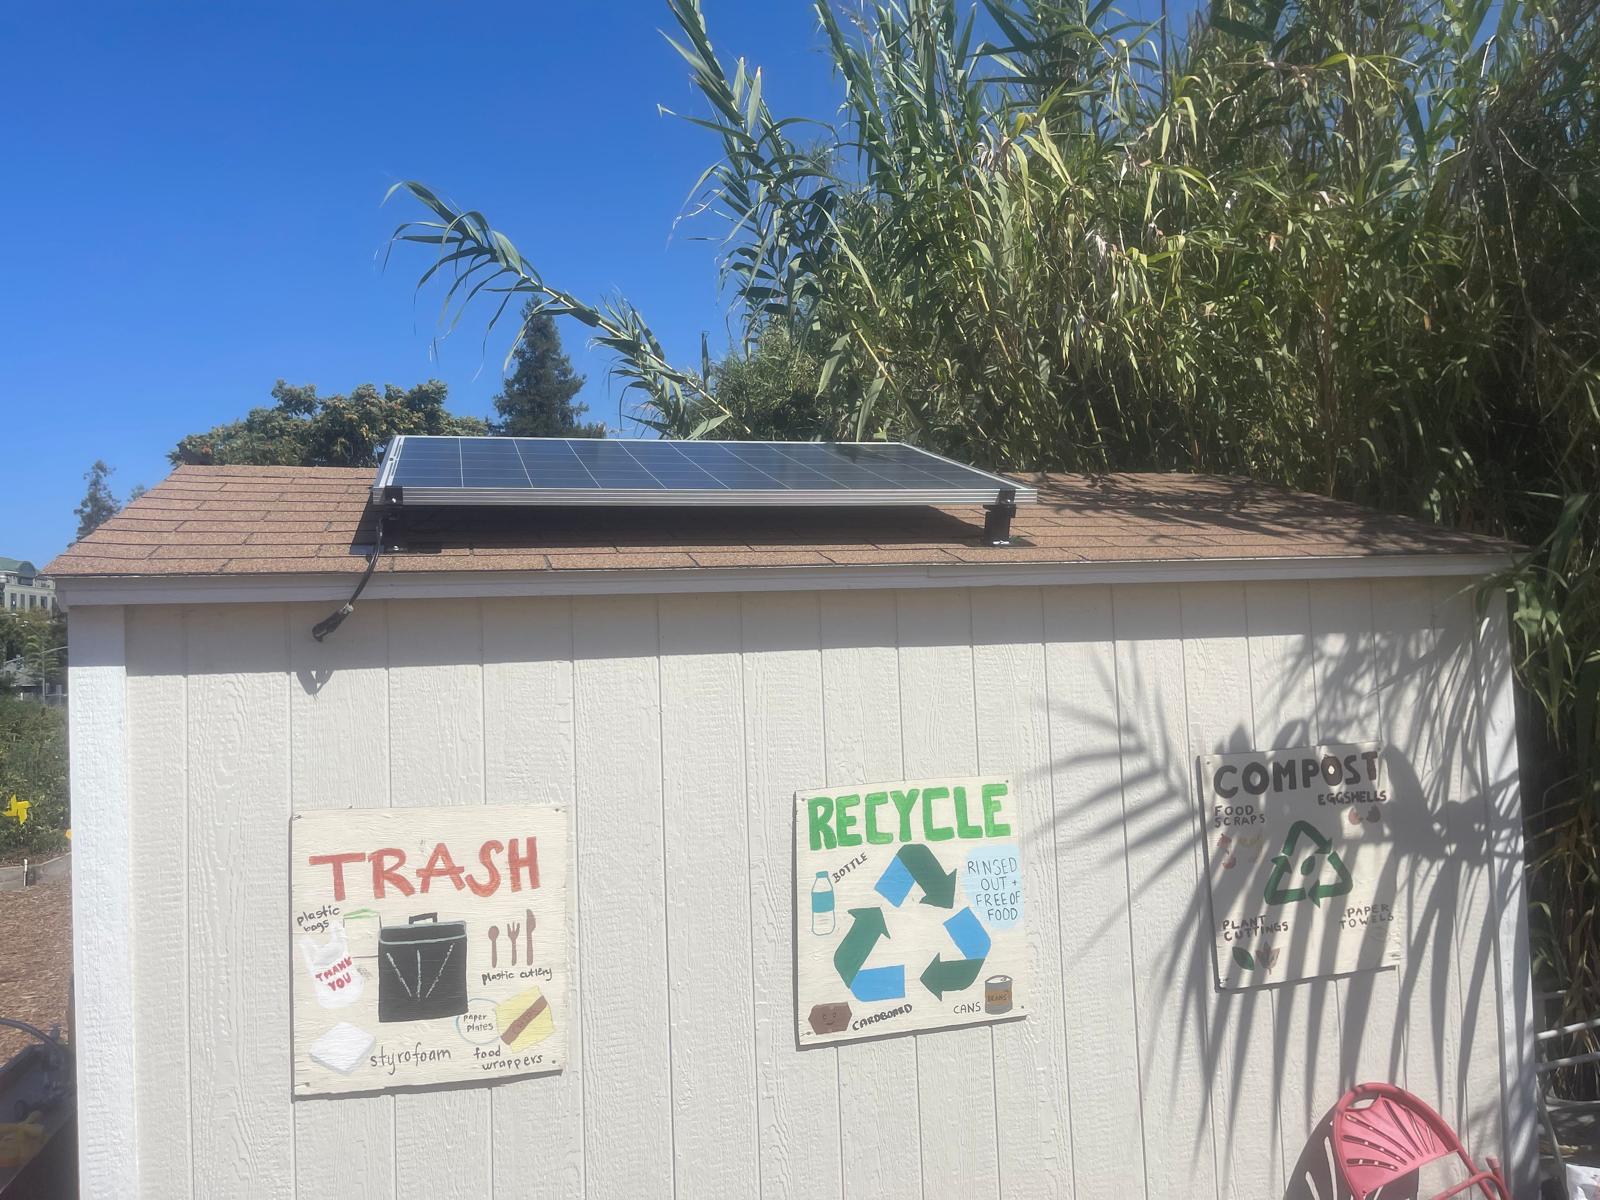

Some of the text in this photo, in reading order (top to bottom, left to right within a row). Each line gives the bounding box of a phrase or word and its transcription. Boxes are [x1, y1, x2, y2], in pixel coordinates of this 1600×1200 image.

[1213, 751, 1378, 799] COMPOST
[1317, 790, 1387, 806] EGGSHELLS
[808, 784, 1012, 850] RECYCLE
[1214, 805, 1254, 817] FOOD
[1214, 813, 1266, 828] SCRAPS
[309, 836, 541, 901] TRASH
[832, 852, 868, 884] BOTTLE
[967, 857, 1018, 876] RINSED
[981, 876, 1007, 891] OUT
[976, 891, 1021, 906] FREE OF
[296, 905, 341, 925] plastic
[987, 907, 1018, 921] FOOD
[1347, 904, 1390, 918] PAPER
[303, 919, 330, 934] bags
[1222, 915, 1268, 930] PLANT
[1340, 914, 1394, 930] TOWELS
[1224, 921, 1289, 941] CUTTINGS
[315, 957, 353, 982] THANK
[481, 967, 553, 986] plastic cutlery
[327, 972, 352, 991] YOU
[953, 1002, 982, 1014] CANS
[463, 1013, 487, 1022] paper
[852, 1003, 913, 1031] CARDBOARD
[466, 1022, 494, 1033] plates
[370, 1042, 451, 1075] styrofoam
[473, 1047, 501, 1060] food
[481, 1053, 543, 1071] wrappers
